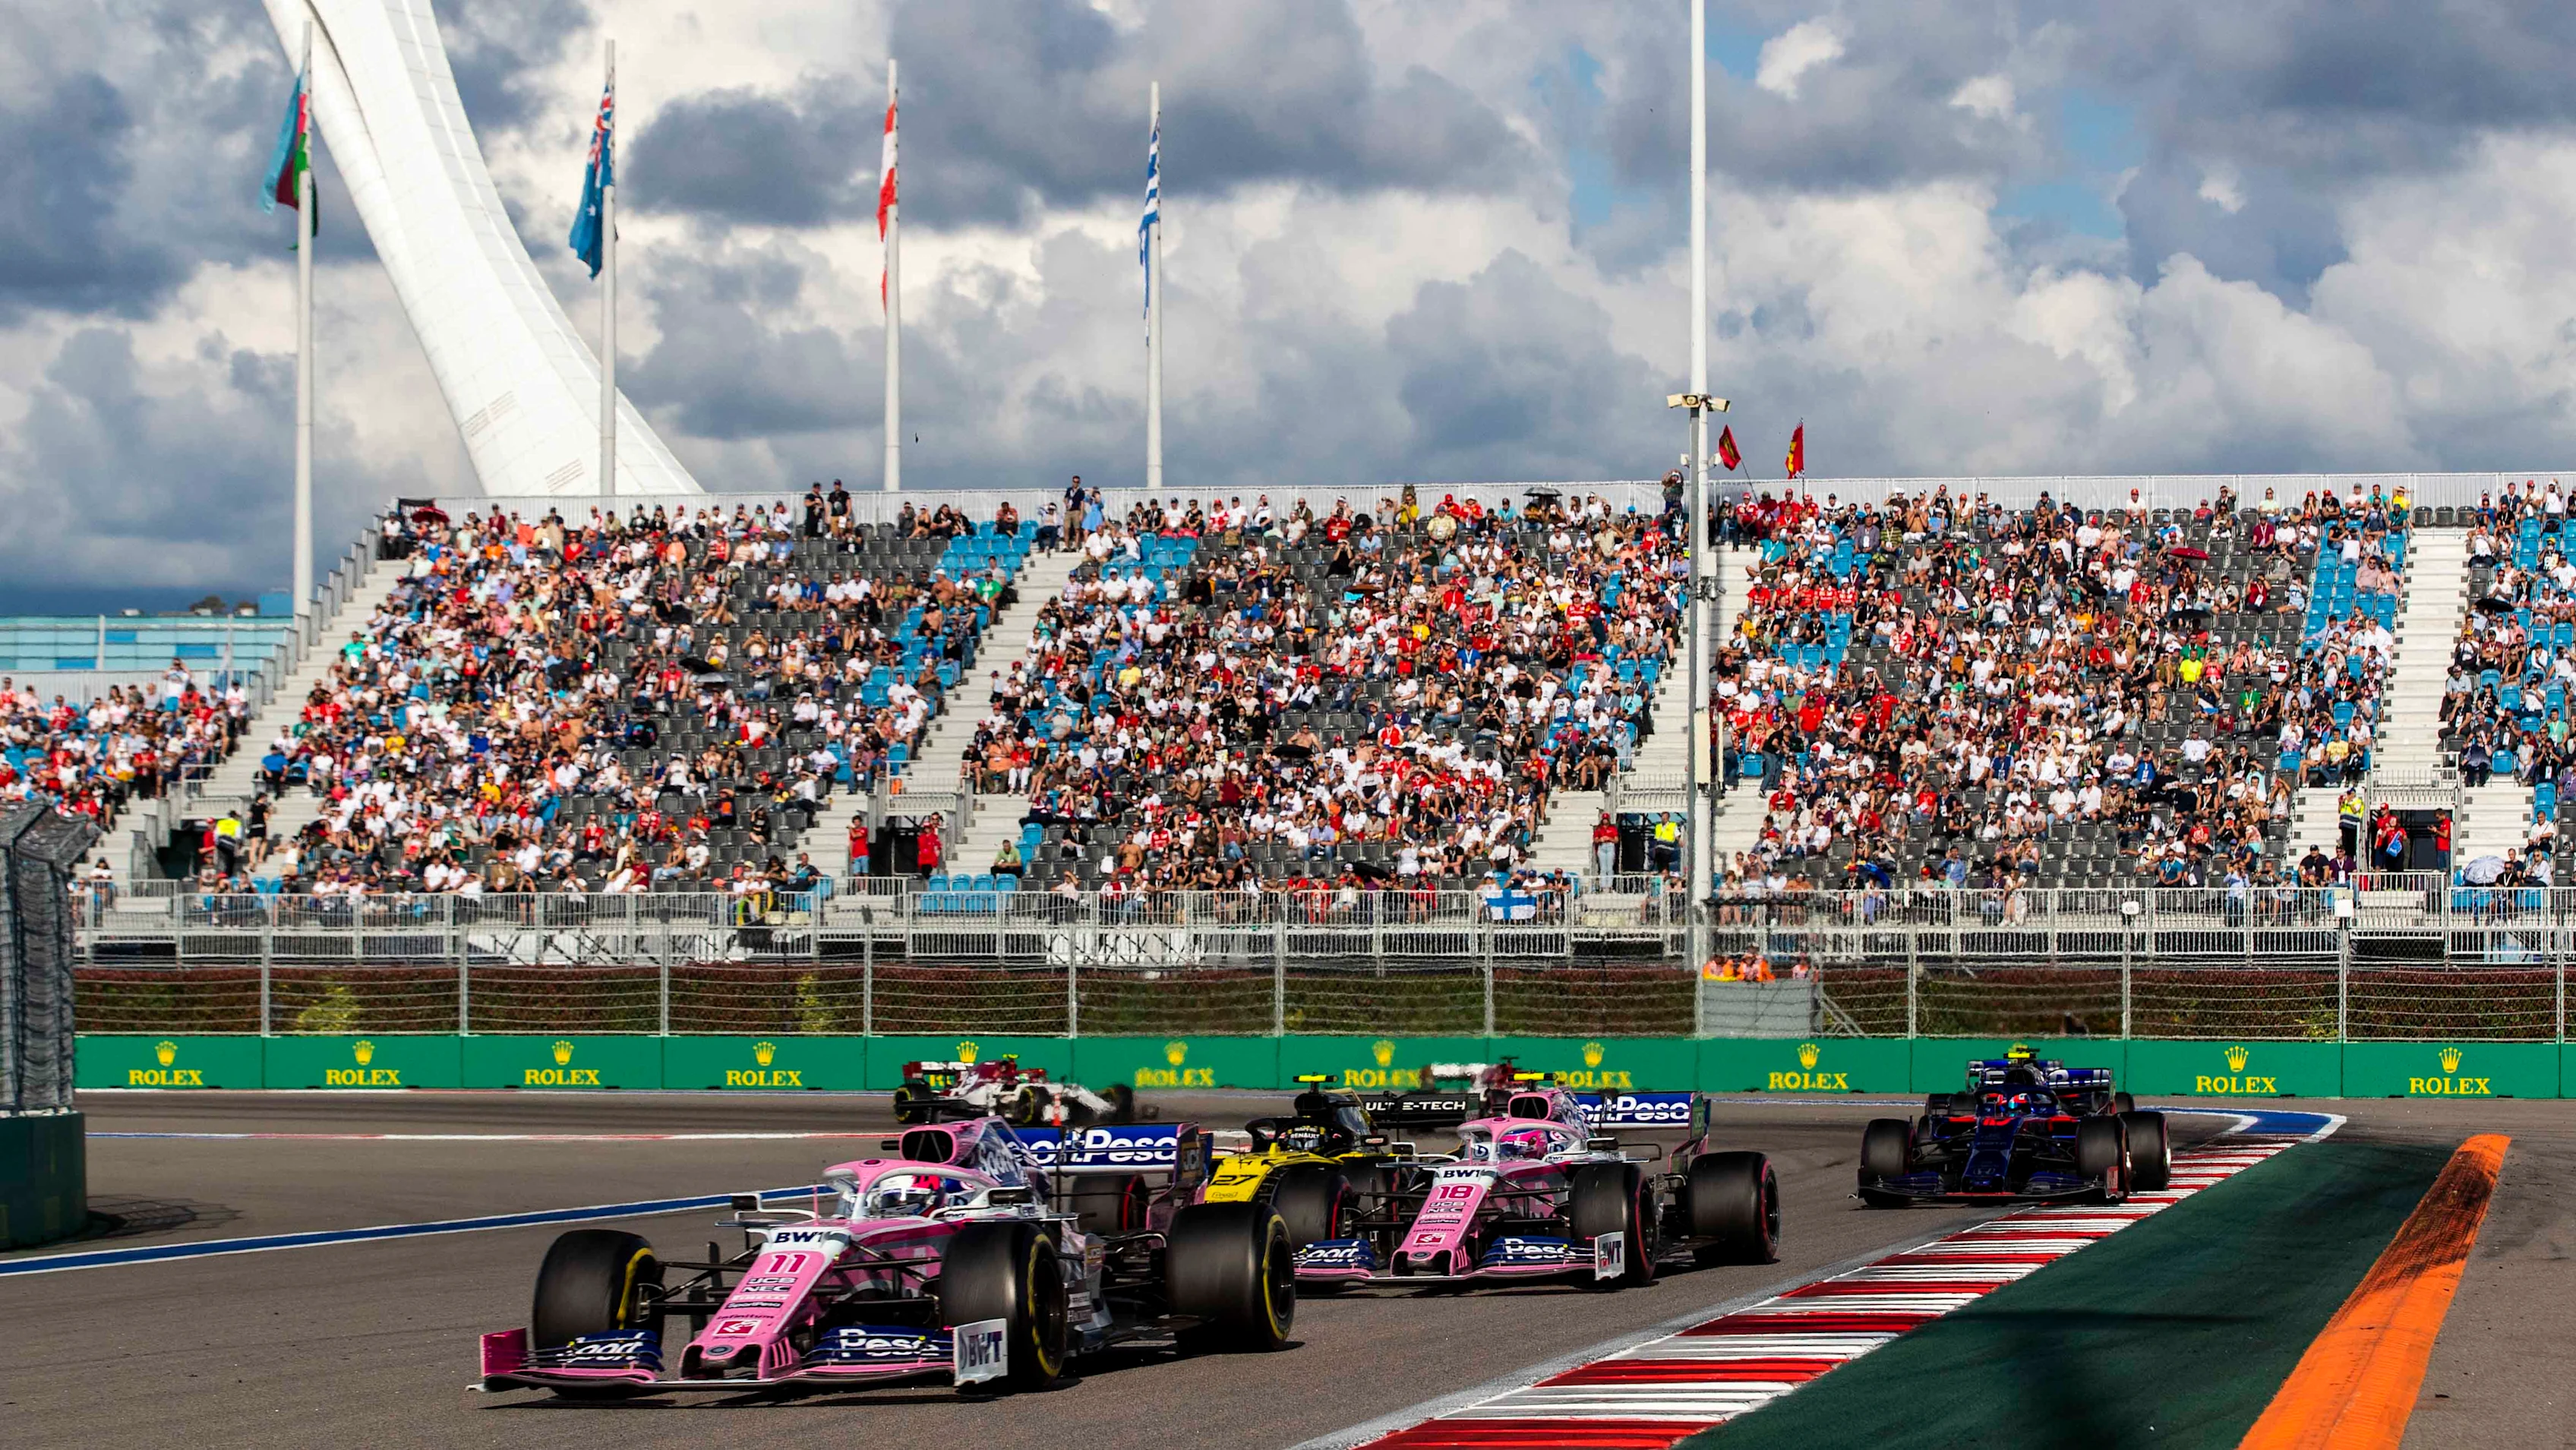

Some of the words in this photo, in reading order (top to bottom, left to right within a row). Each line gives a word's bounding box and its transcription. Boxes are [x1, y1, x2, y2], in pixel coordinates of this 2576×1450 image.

[129, 1069, 203, 1085] ROLEX
[326, 1069, 400, 1085] ROLEX
[525, 1069, 600, 1085] ROLEX
[726, 1069, 802, 1086] ROLEX
[1135, 1068, 1214, 1087] ROLEX
[1553, 1071, 1632, 1088] ROLEX
[1769, 1072, 1848, 1089] ROLEX
[2196, 1076, 2277, 1094] ROLEX
[2409, 1077, 2491, 1095] ROLEX
[1402, 1101, 1466, 1110] E-TECH
[1577, 1096, 1690, 1122] ortPesa
[1006, 1129, 1177, 1164] ortPesa
[1211, 1174, 1258, 1186] 27
[1438, 1186, 1474, 1199] 18
[767, 1254, 809, 1273] 11
